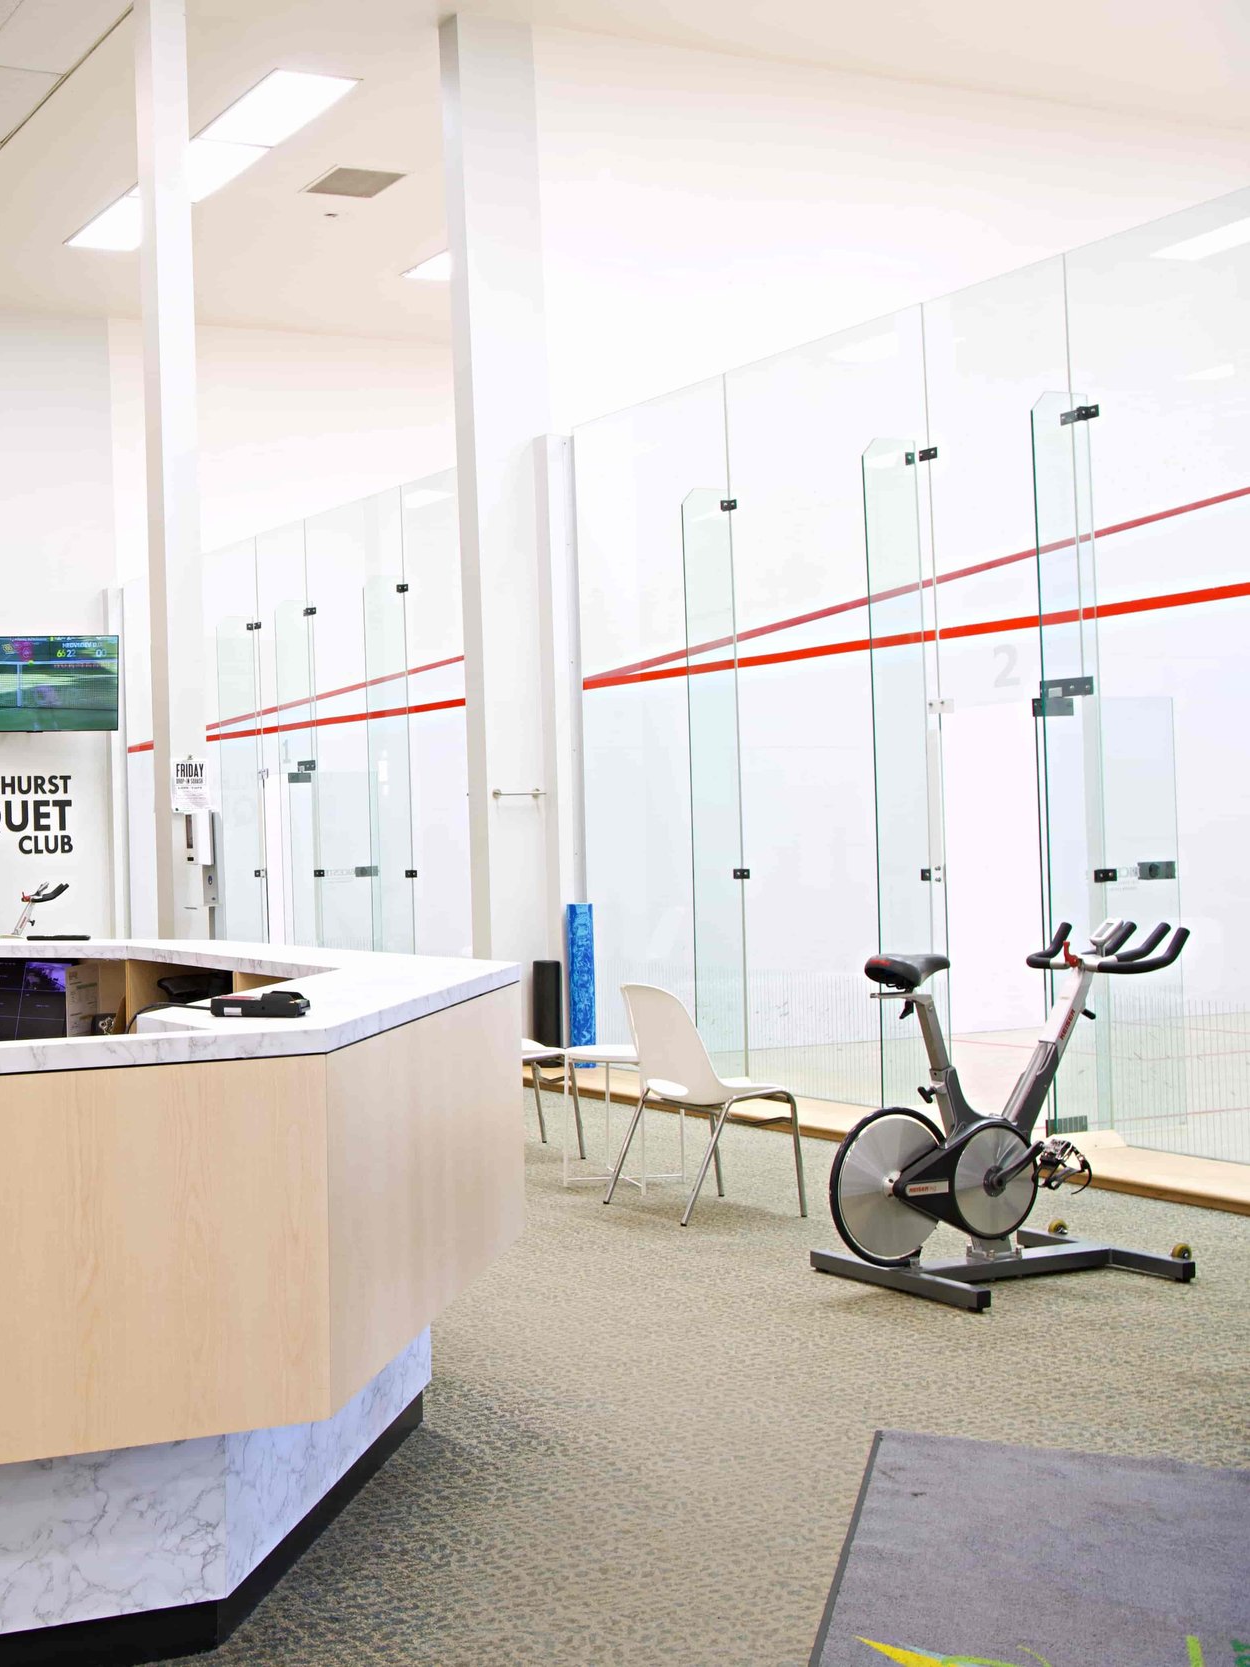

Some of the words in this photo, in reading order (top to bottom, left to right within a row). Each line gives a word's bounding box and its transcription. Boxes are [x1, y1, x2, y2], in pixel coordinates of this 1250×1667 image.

[992, 644, 1021, 688] 2
[175, 763, 204, 778] FRIDAY
[18, 834, 73, 855] CLUB
